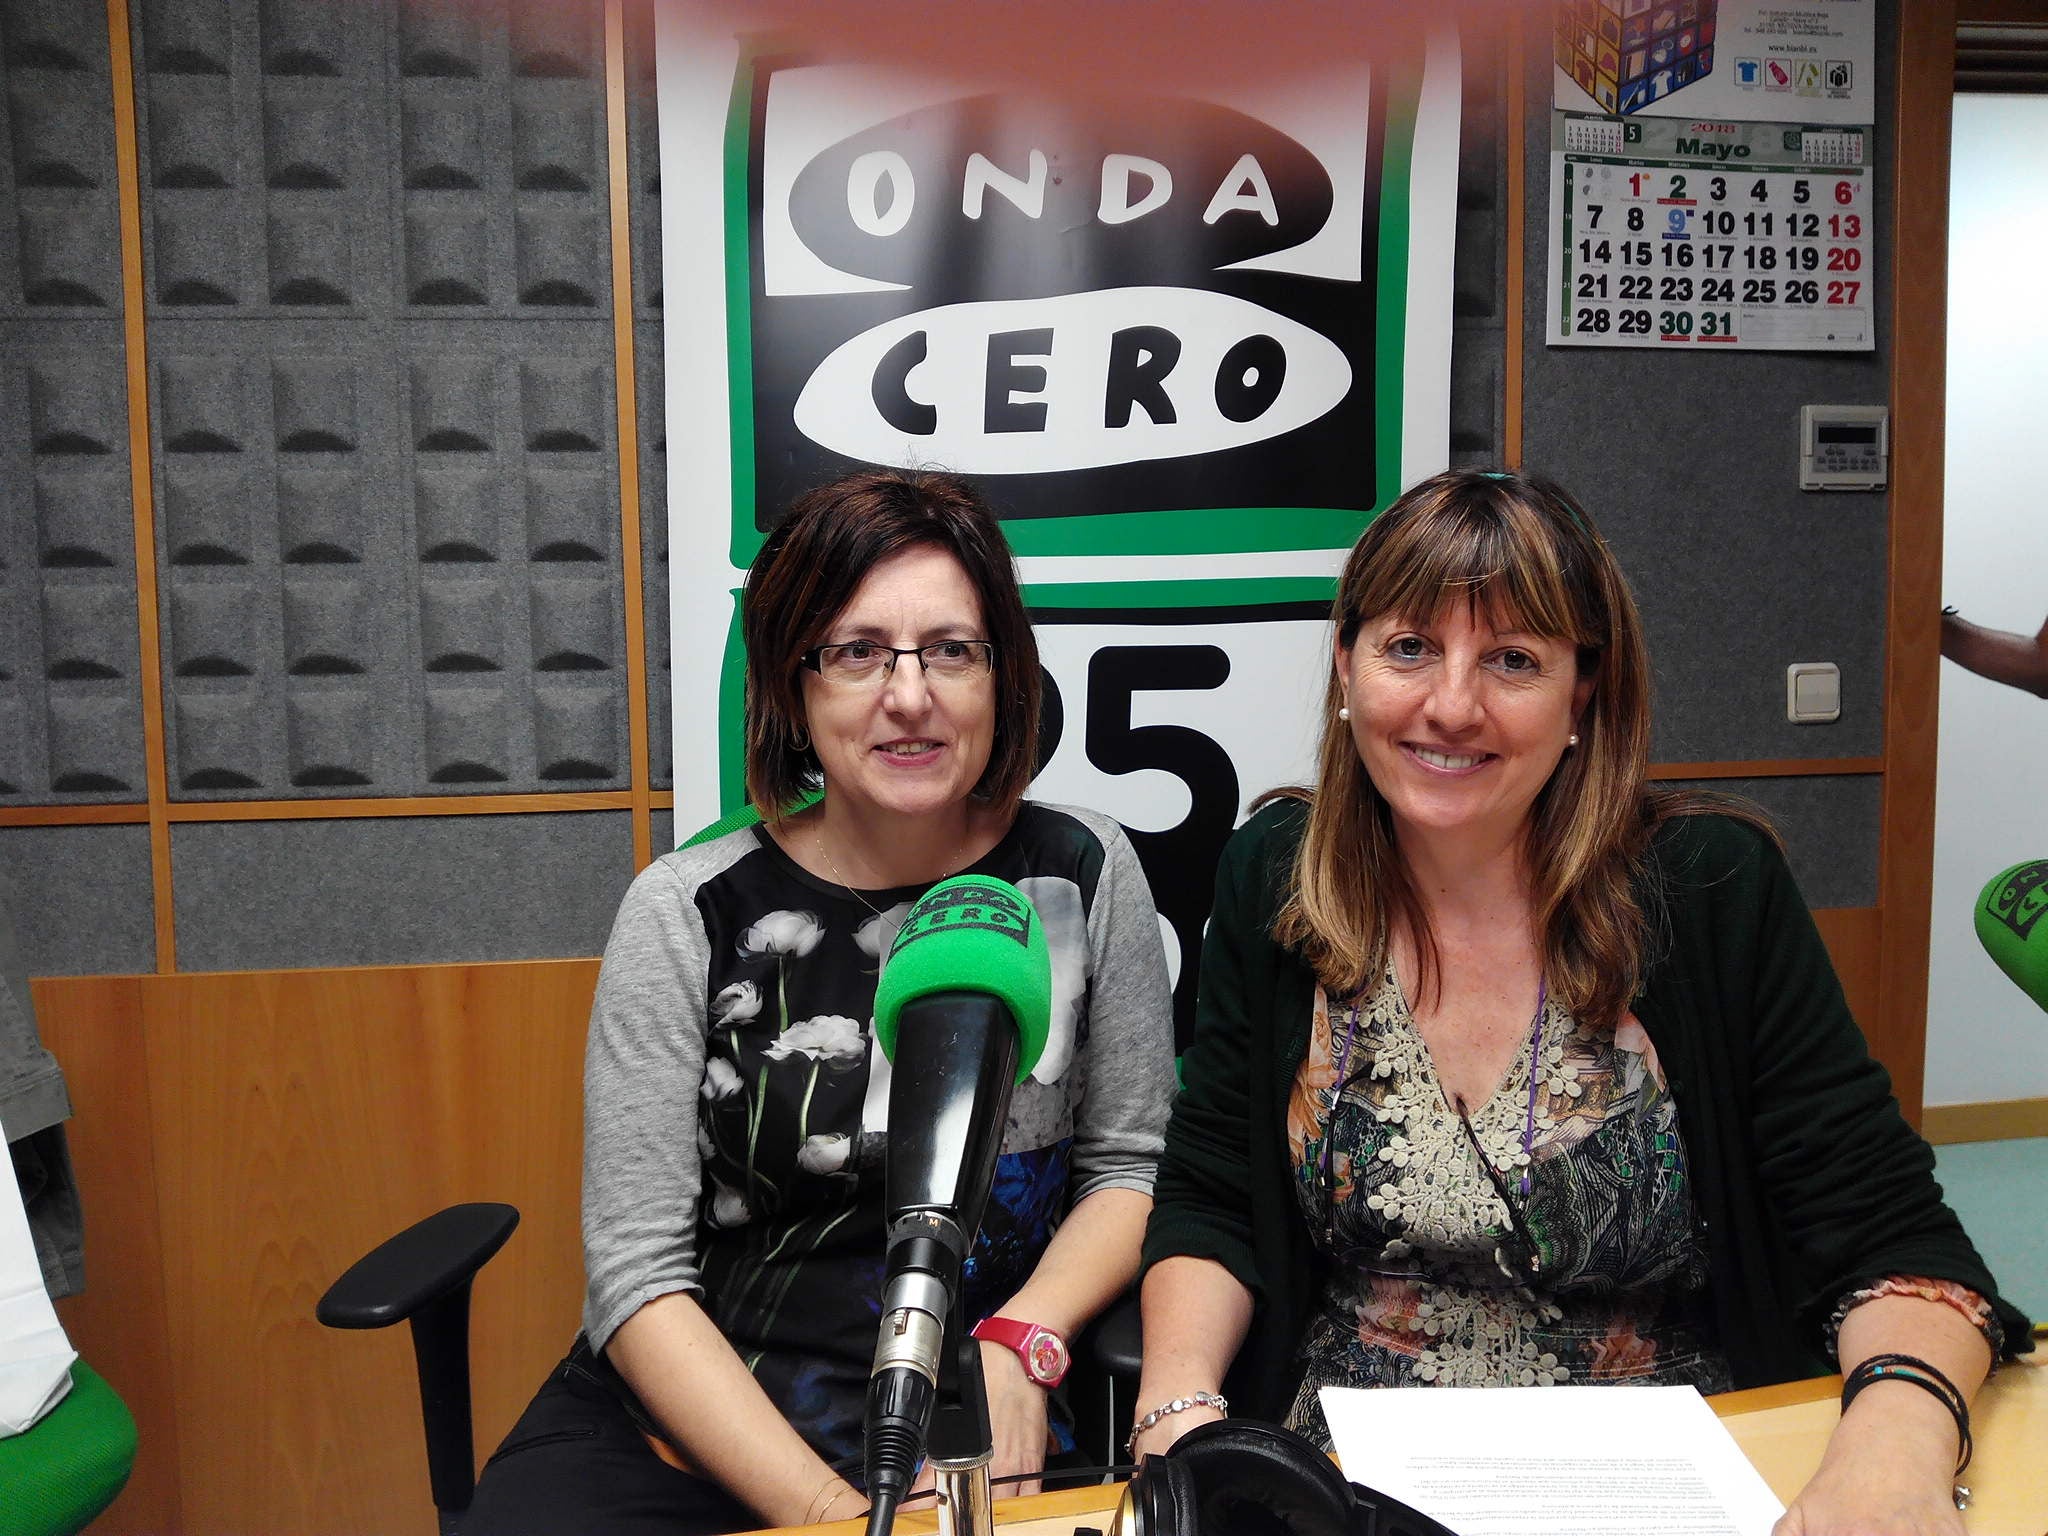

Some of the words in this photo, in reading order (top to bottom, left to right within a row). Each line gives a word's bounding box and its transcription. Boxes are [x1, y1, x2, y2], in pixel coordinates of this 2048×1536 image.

[1629, 126, 1636, 140] 5
[1690, 122, 1736, 134] 2018
[1675, 137, 1751, 162] Mayo
[847, 150, 1279, 237] ONDA
[1629, 172, 1640, 197] 1
[1669, 174, 1687, 198] 2
[1710, 177, 1726, 201] 3
[1750, 179, 1768, 202] 4
[1793, 180, 1810, 203] 5
[1835, 181, 1852, 205] 6
[1587, 204, 1603, 229] 7
[1627, 207, 1644, 231] 8
[1668, 208, 1686, 233] 9
[1703, 210, 1735, 235] 10
[1744, 212, 1773, 236] 11
[1786, 213, 1819, 237] 12
[1828, 214, 1861, 238] 13
[1579, 239, 1612, 264] 14
[1620, 240, 1653, 266] 15
[1661, 242, 1694, 268] 16
[1702, 244, 1735, 269] 17
[1743, 246, 1776, 270] 18
[1786, 246, 1819, 271] 19
[1827, 247, 1861, 271] 20
[1577, 273, 1608, 298] 21
[1619, 275, 1653, 299] 22
[1660, 277, 1694, 301] 23
[1701, 278, 1735, 302] 24
[1743, 279, 1777, 303] 25
[1785, 280, 1819, 304] 26
[1827, 281, 1861, 304] 27
[1577, 308, 1611, 333] 28
[1618, 309, 1652, 334] 29
[1659, 310, 1693, 335] 30
[1700, 311, 1731, 336] 31
[871, 325, 1287, 436] CERO
[905, 907, 1009, 936] CERO
